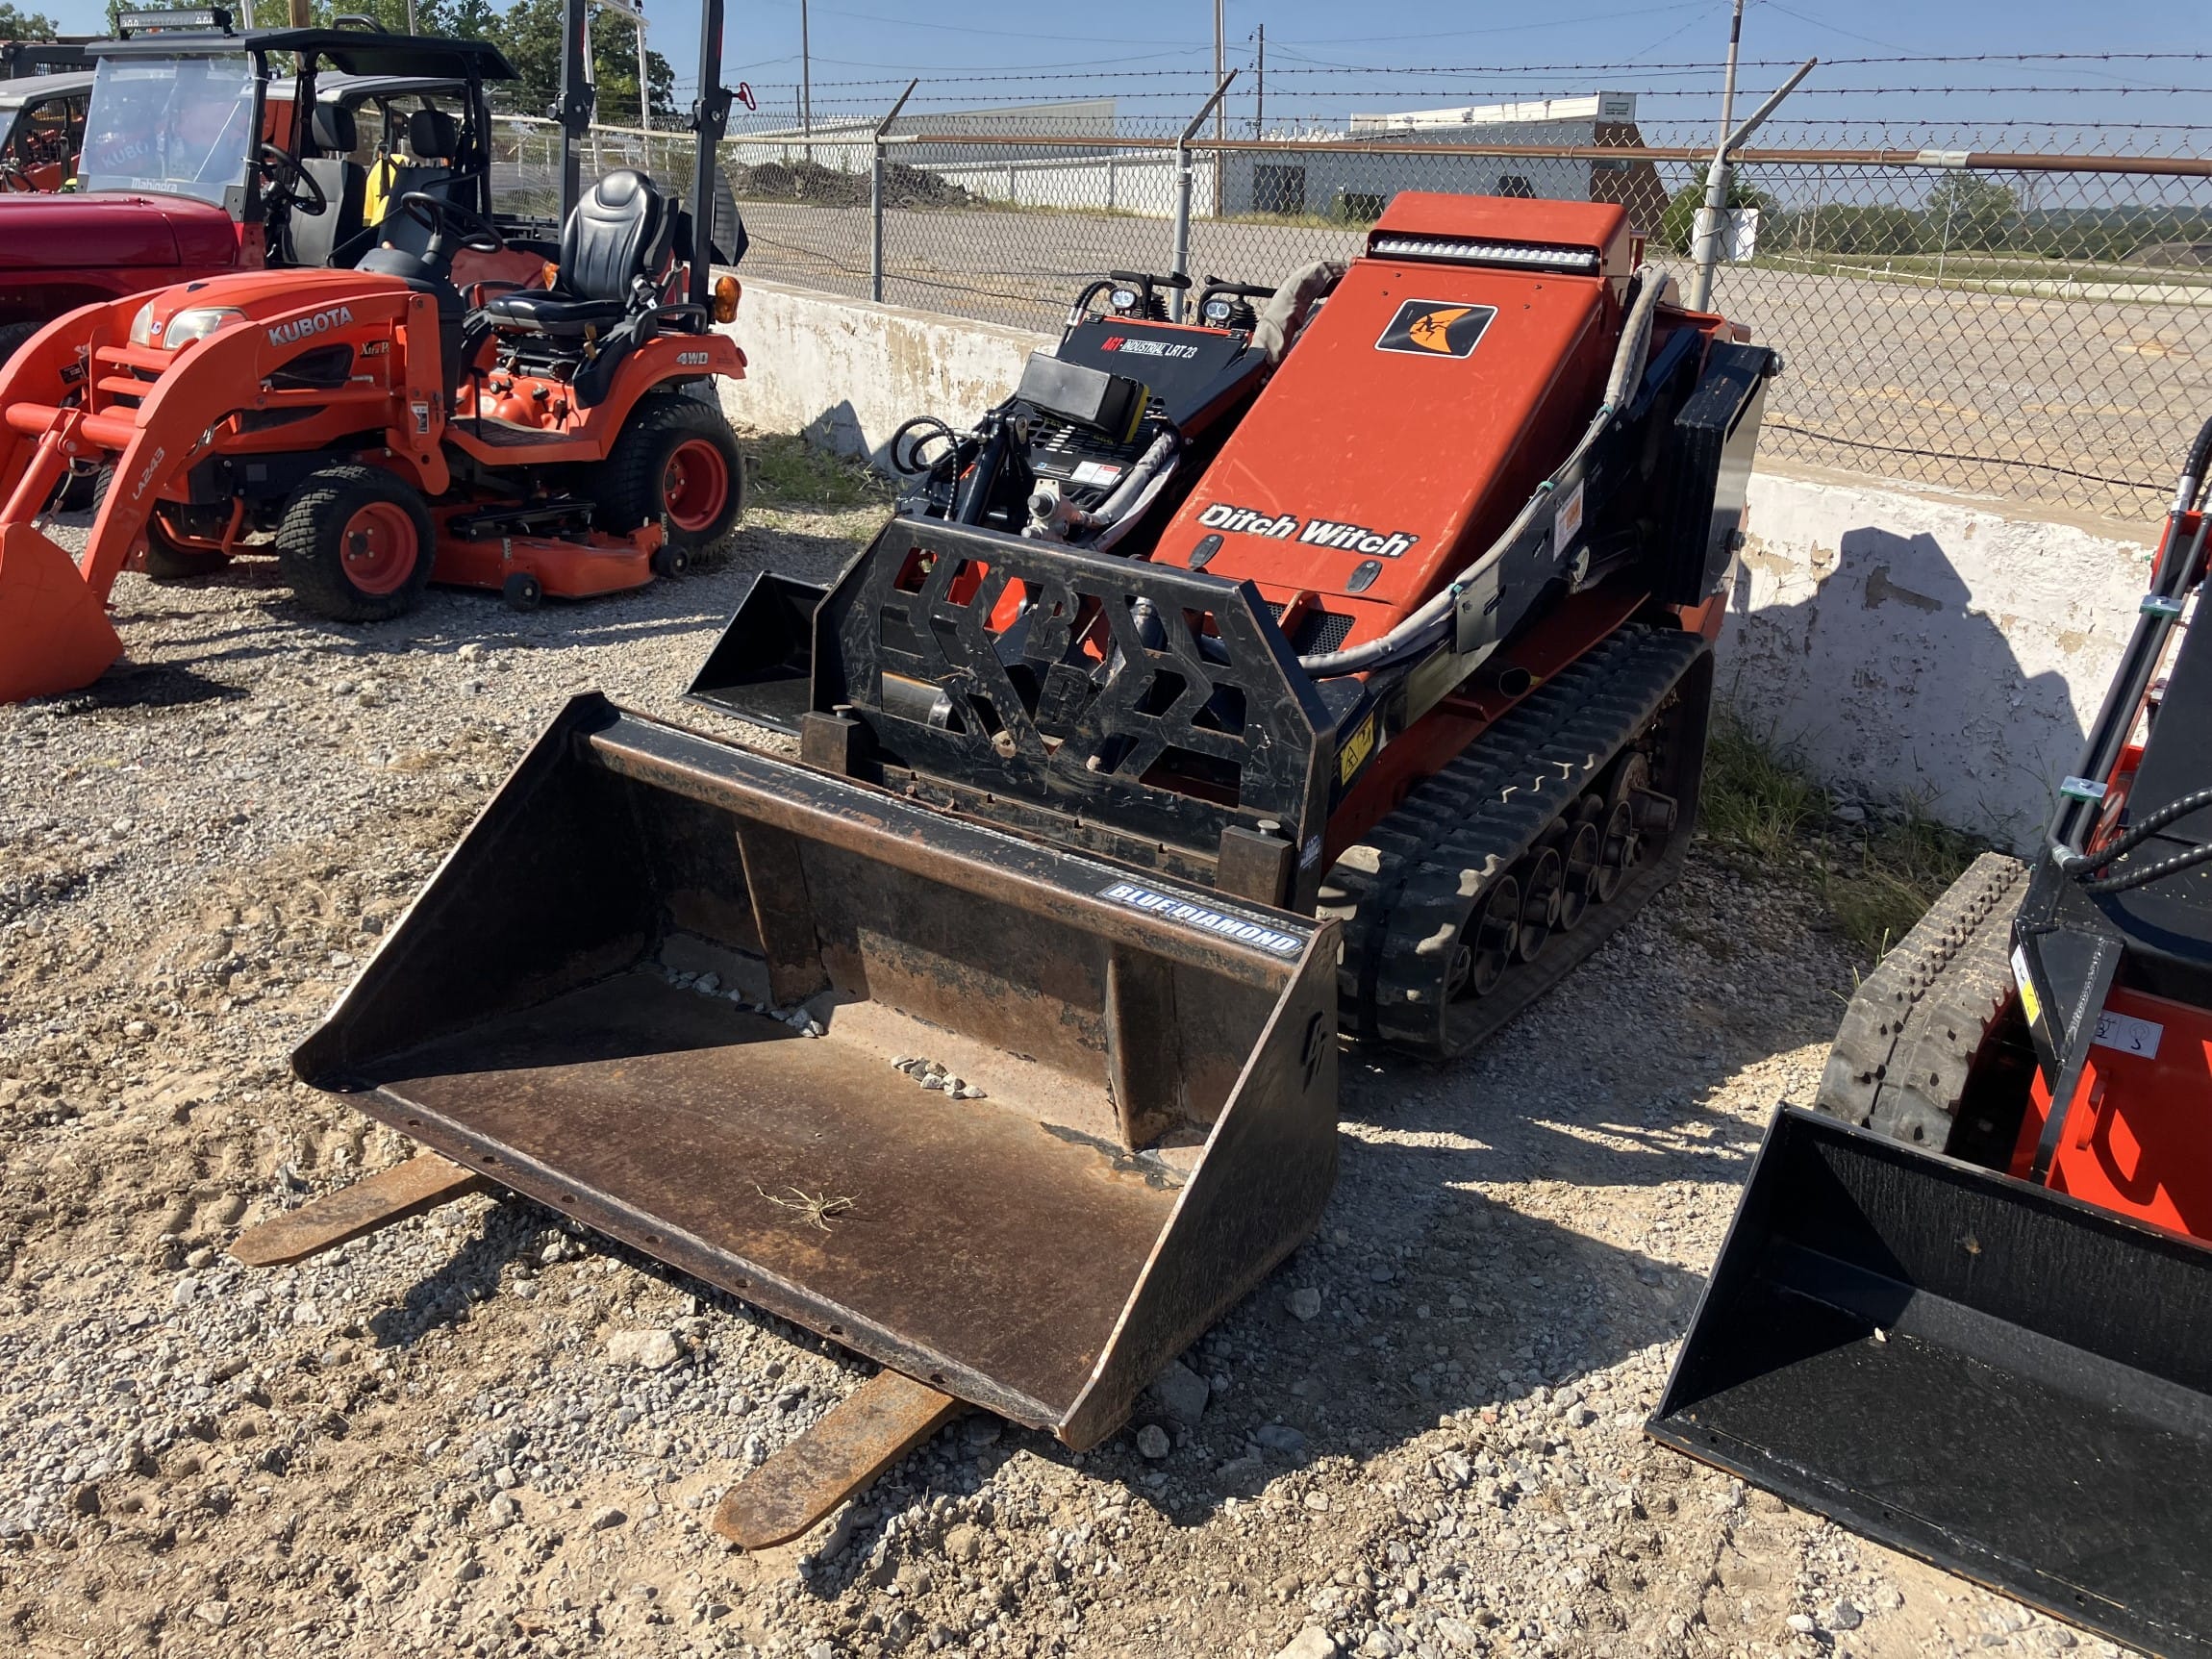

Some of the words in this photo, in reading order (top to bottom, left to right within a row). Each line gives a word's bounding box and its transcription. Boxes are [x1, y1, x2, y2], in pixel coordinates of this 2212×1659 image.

[132, 177, 178, 192] Mahindra
[268, 306, 354, 346] KUBOTA
[676, 352, 709, 364] 4WD
[1165, 344, 1187, 358] LRT
[1182, 346, 1198, 359] 23
[132, 446, 165, 500] LA243
[1199, 504, 1296, 540] Ditch
[1108, 884, 1172, 912] BLUE
[1172, 904, 1298, 951] DIAMOND
